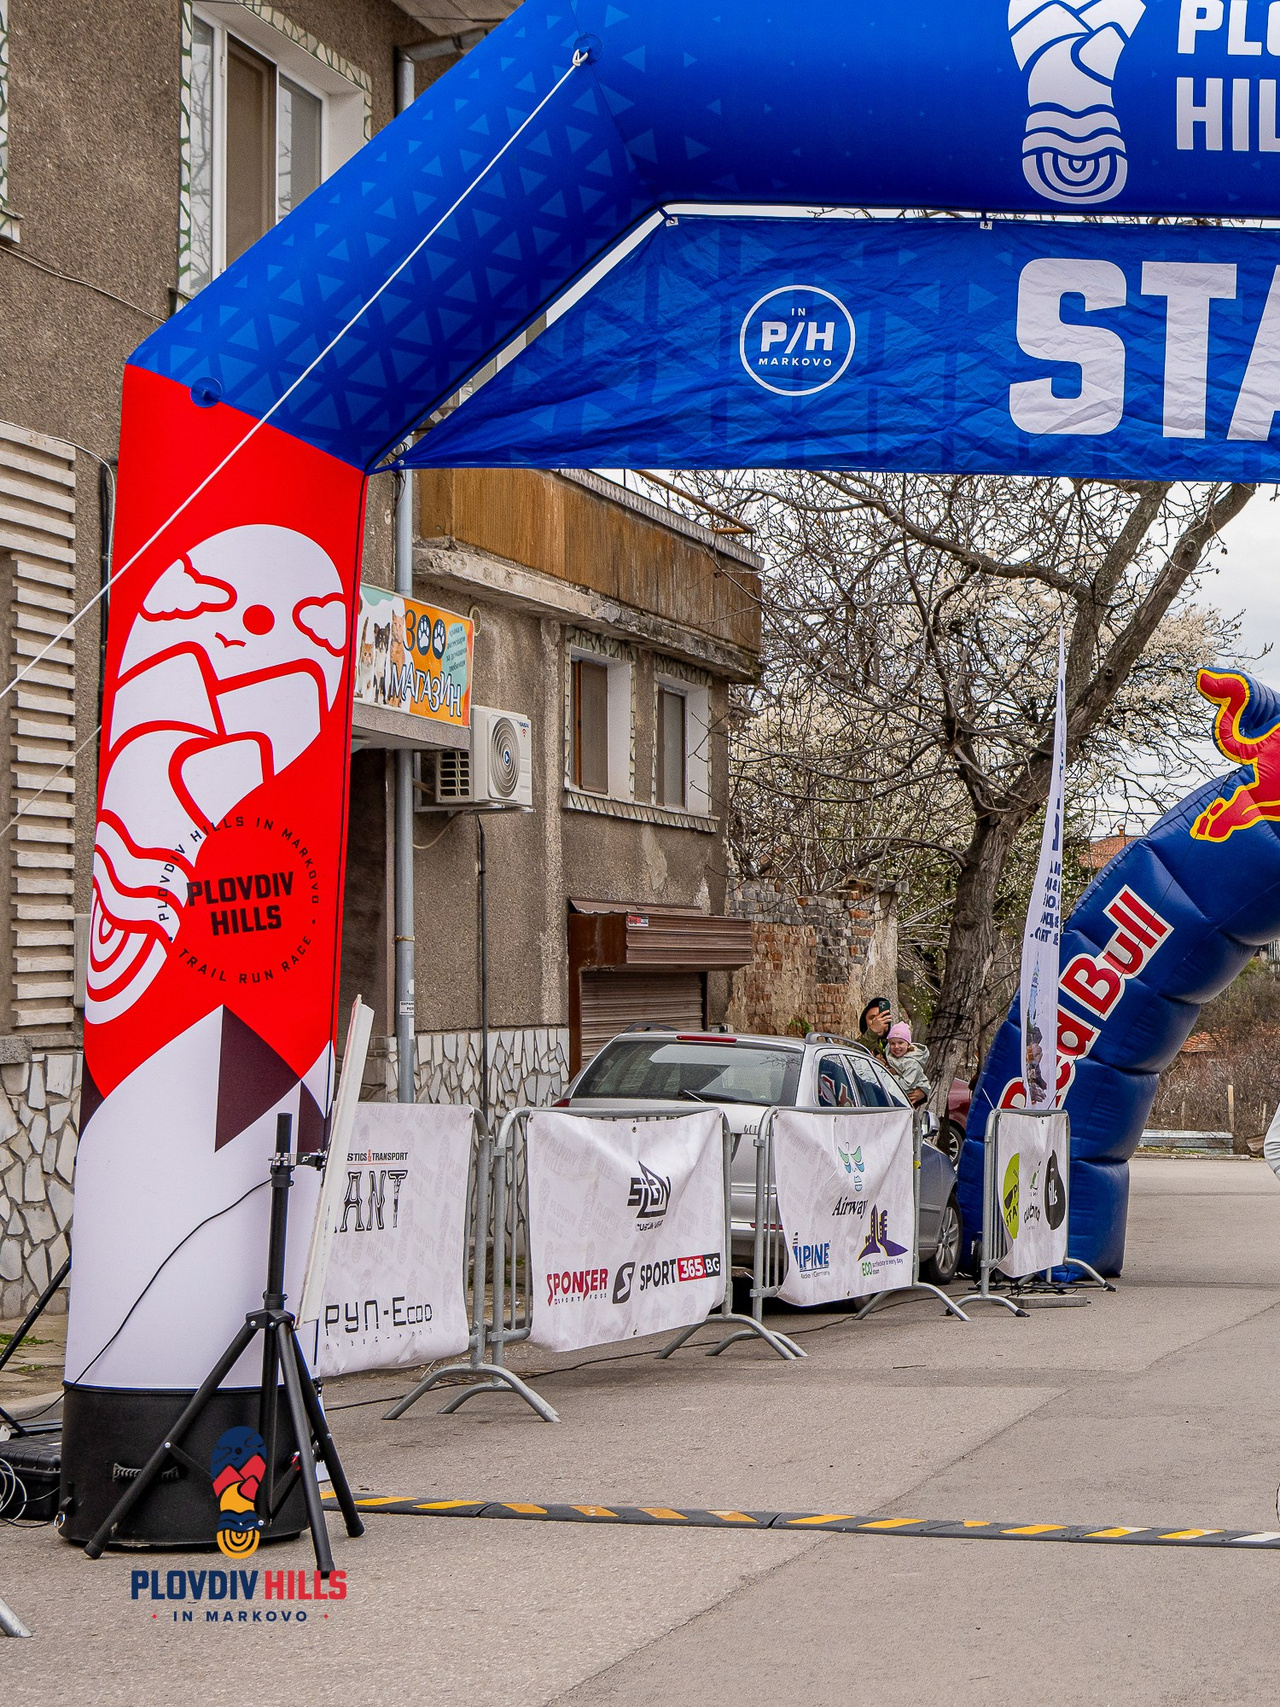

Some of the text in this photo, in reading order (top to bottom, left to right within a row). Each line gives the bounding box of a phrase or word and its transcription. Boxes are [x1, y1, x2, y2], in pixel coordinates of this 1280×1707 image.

[791, 308, 806, 316] IN
[761, 321, 835, 354] P/H
[758, 357, 832, 367] MARKOVO
[390, 662, 461, 717] МАГАЗИН
[158, 816, 319, 922] PLOVDIV HILLS IN MARKOVO
[186, 871, 294, 907] PLOVDIV
[210, 905, 282, 936] HILLS
[178, 936, 312, 984] TRAIL RUN RACE
[1060, 888, 1170, 1017] Bull
[335, 1169, 409, 1234] ANT
[832, 1197, 868, 1219] Airway
[547, 1268, 608, 1306] SPONSER
